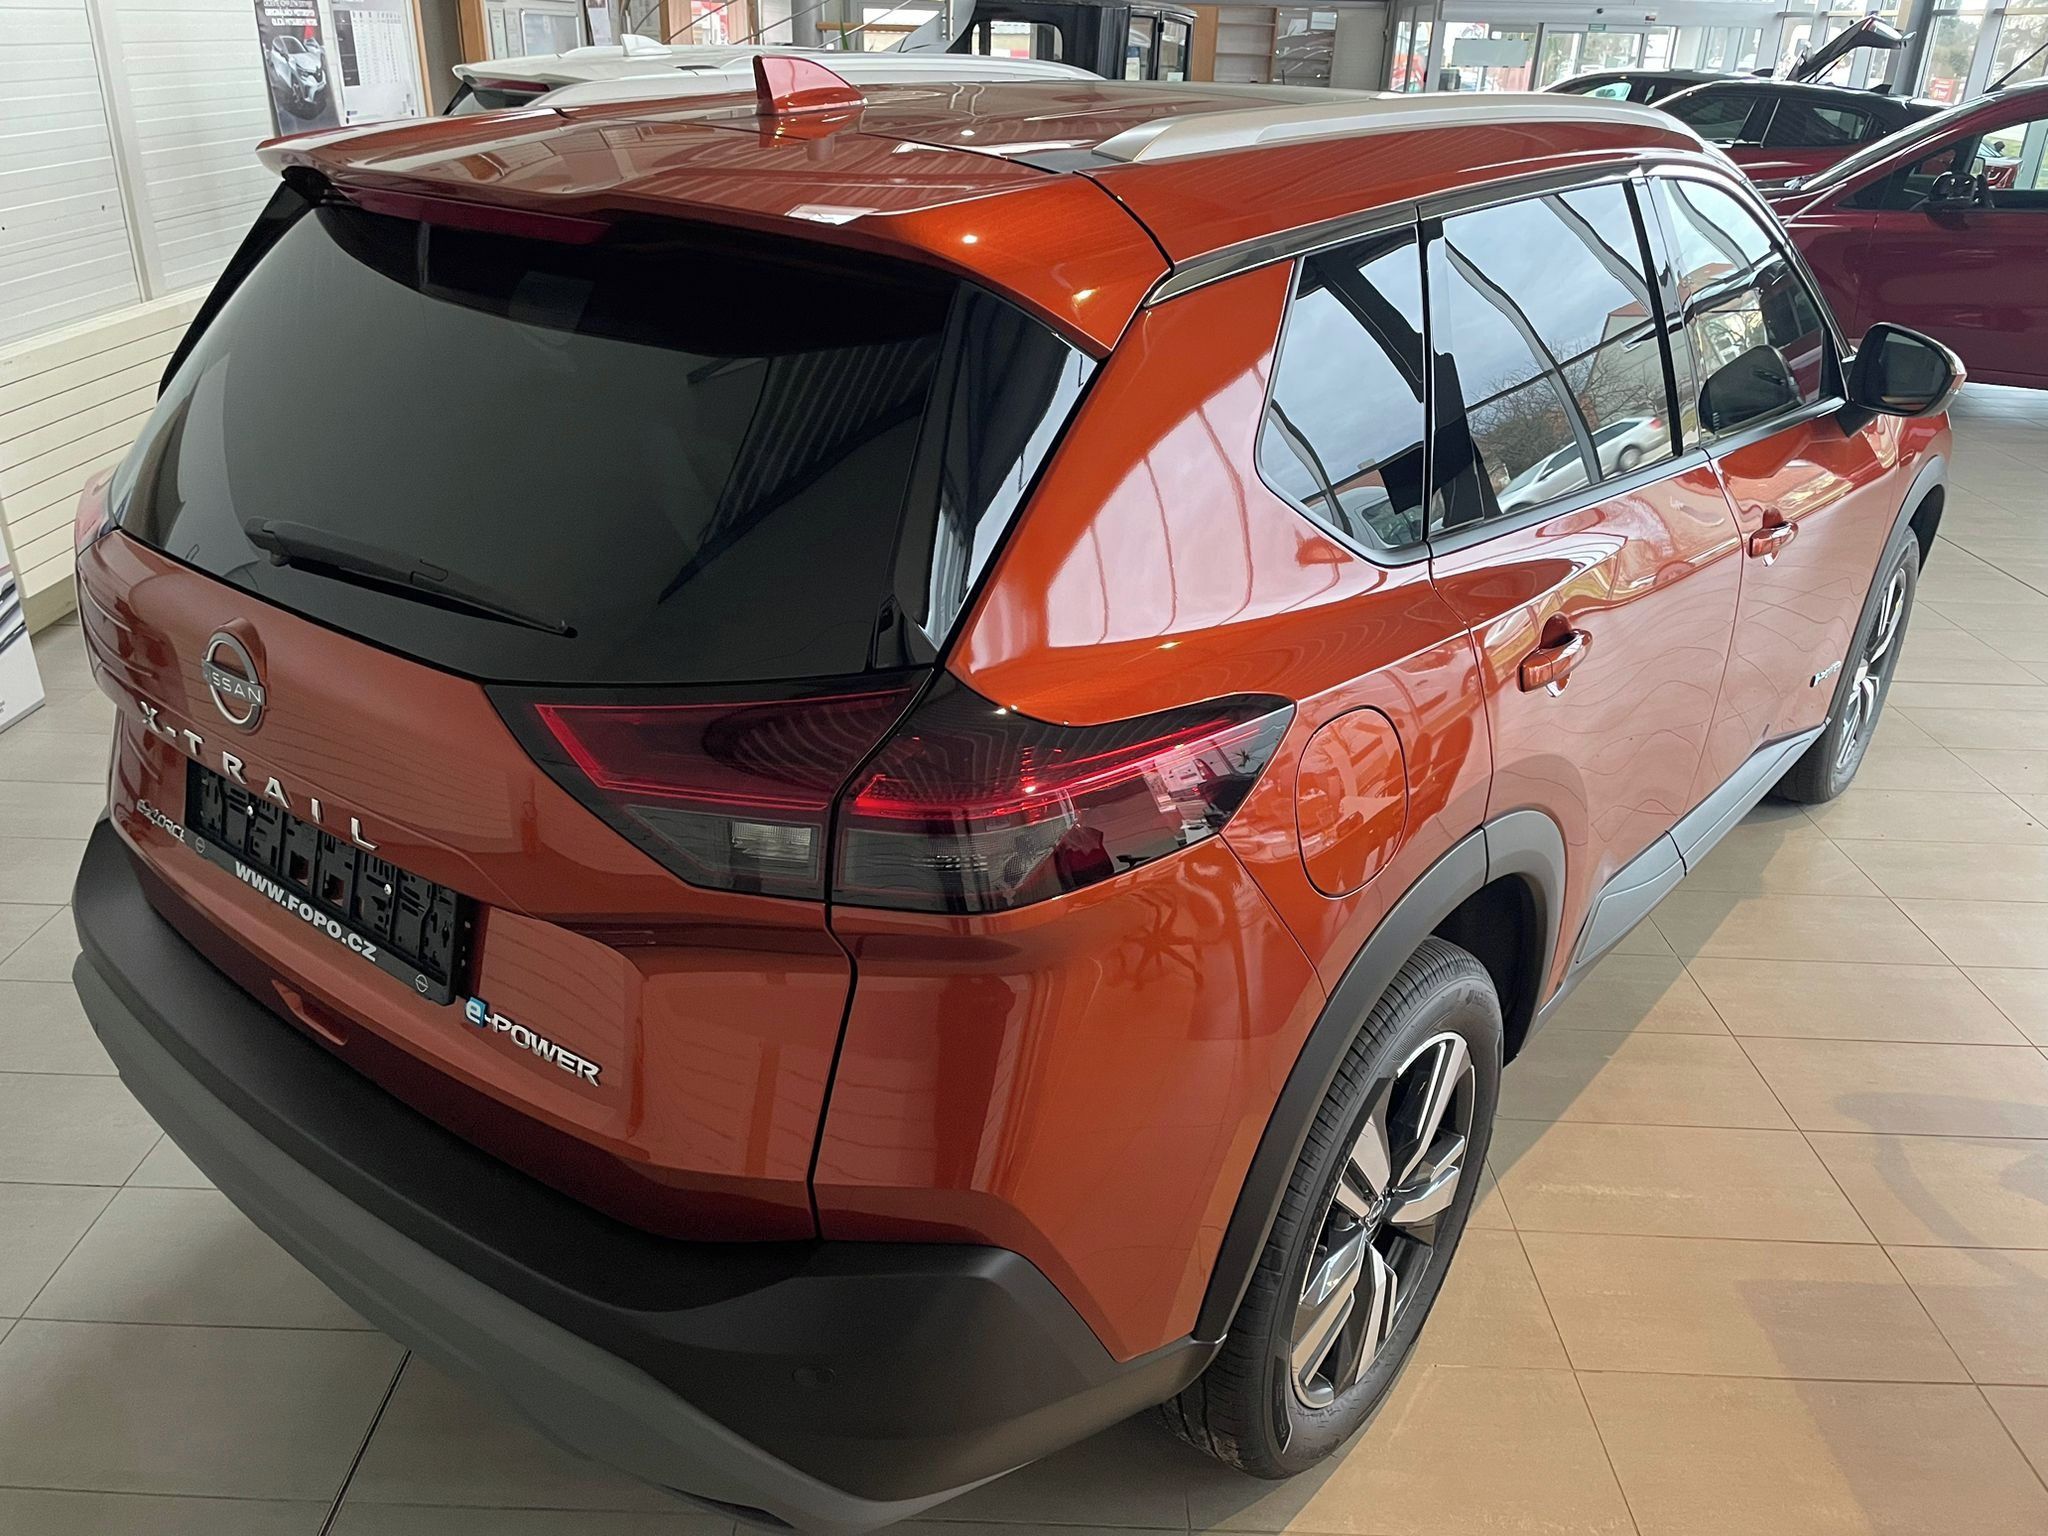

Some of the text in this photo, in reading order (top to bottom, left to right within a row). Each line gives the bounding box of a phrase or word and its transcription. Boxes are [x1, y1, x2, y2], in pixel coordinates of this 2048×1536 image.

[206, 668, 262, 703] SSAN
[140, 701, 378, 851] X-TRAIL
[235, 861, 377, 962] WWW.FOPO.CZ
[465, 998, 601, 1087] e-POWER
